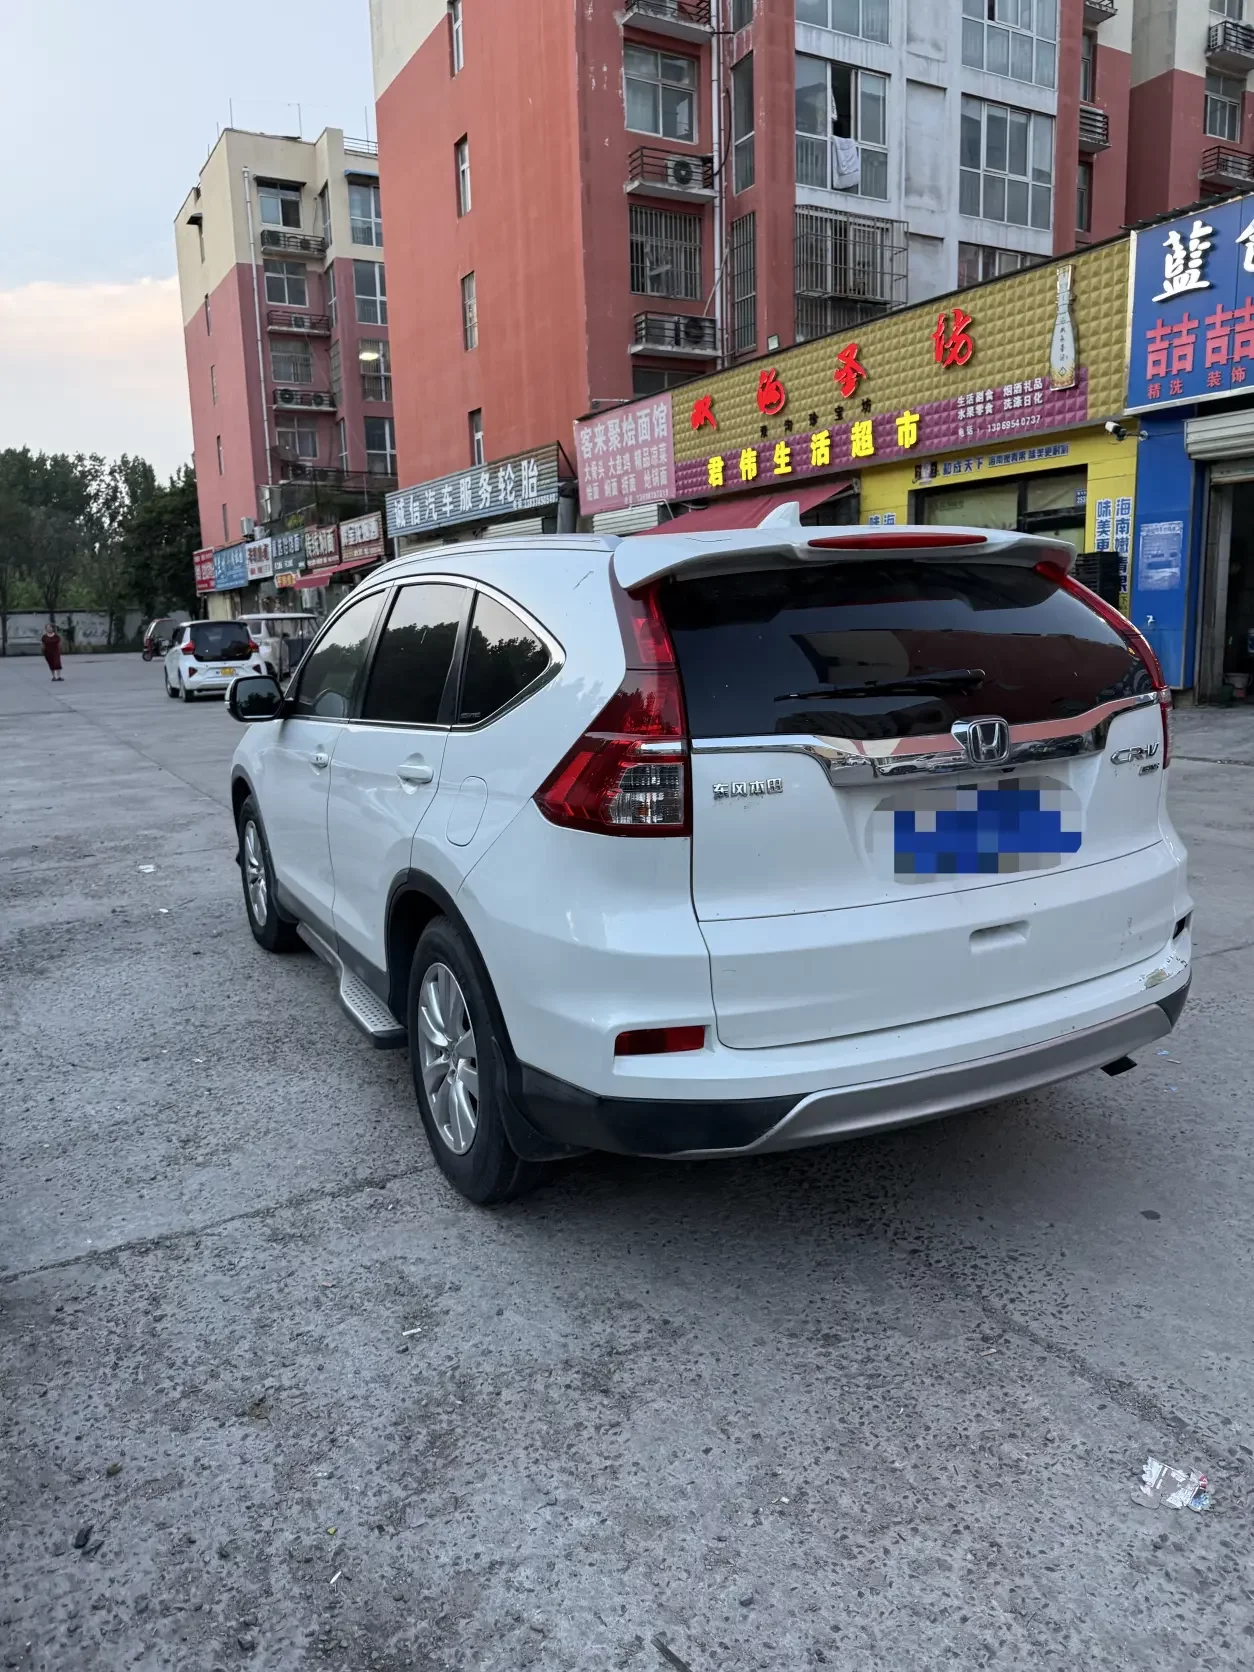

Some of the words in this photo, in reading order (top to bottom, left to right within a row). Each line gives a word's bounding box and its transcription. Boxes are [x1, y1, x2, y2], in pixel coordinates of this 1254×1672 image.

[1003, 378, 1043, 397] 烟酒礼品
[1147, 379, 1184, 400] 精洗
[1207, 366, 1247, 388] 装饰
[957, 402, 994, 420] 水果零食
[1003, 391, 1043, 410] 洗涤日化
[708, 411, 920, 487] 君伟生活超市
[394, 458, 539, 528] 诚信汽车服务轮胎
[1111, 742, 1159, 765] CR-V
[712, 778, 783, 800] 东风本田
